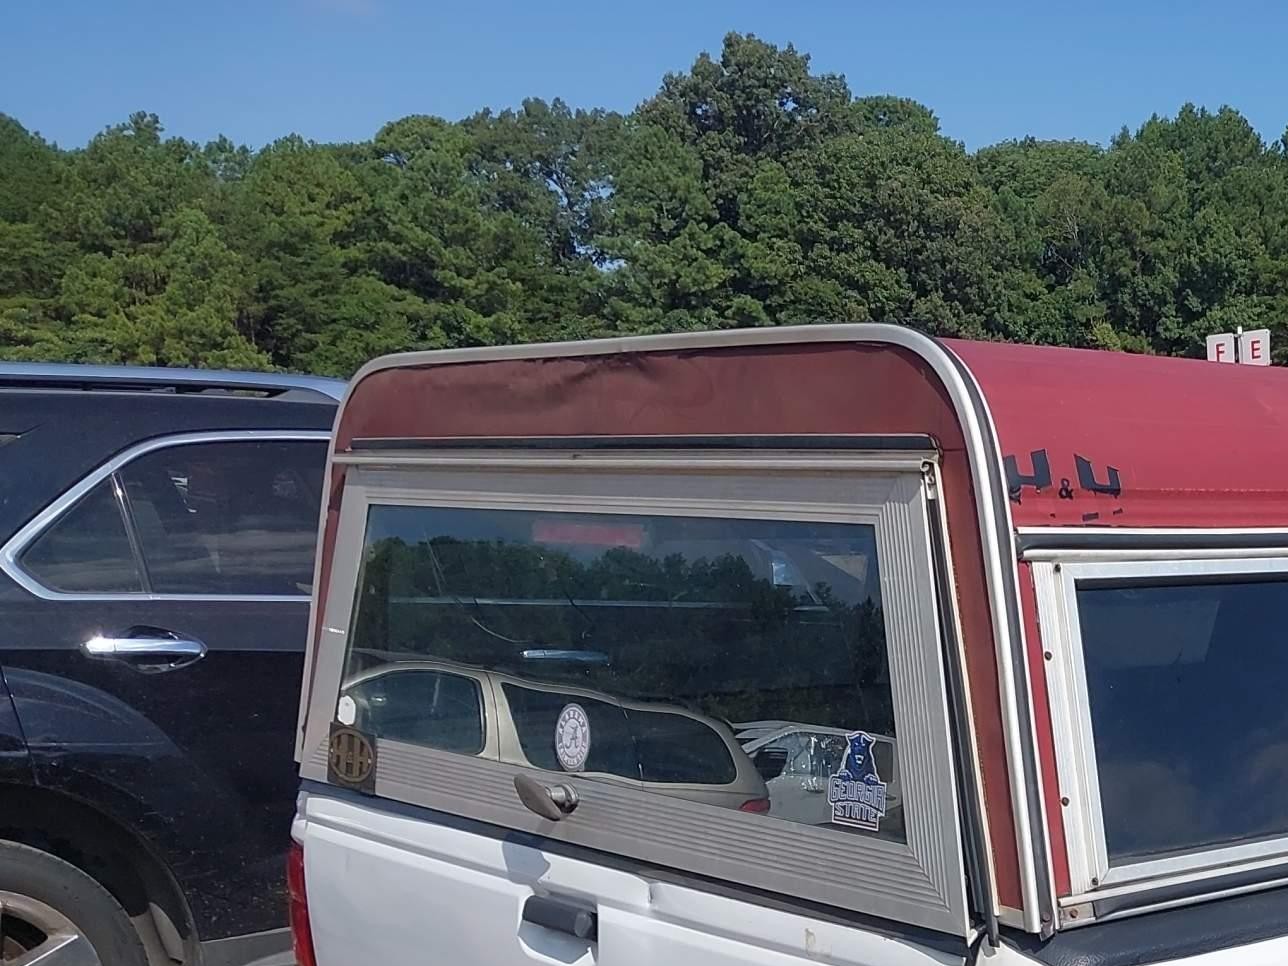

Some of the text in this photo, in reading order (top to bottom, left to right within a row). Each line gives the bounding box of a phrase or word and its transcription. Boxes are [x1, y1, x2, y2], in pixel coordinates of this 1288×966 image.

[1216, 343, 1225, 361] F
[1251, 340, 1261, 359] E
[830, 777, 886, 812] GEORGIA
[834, 801, 878, 822] STATE
